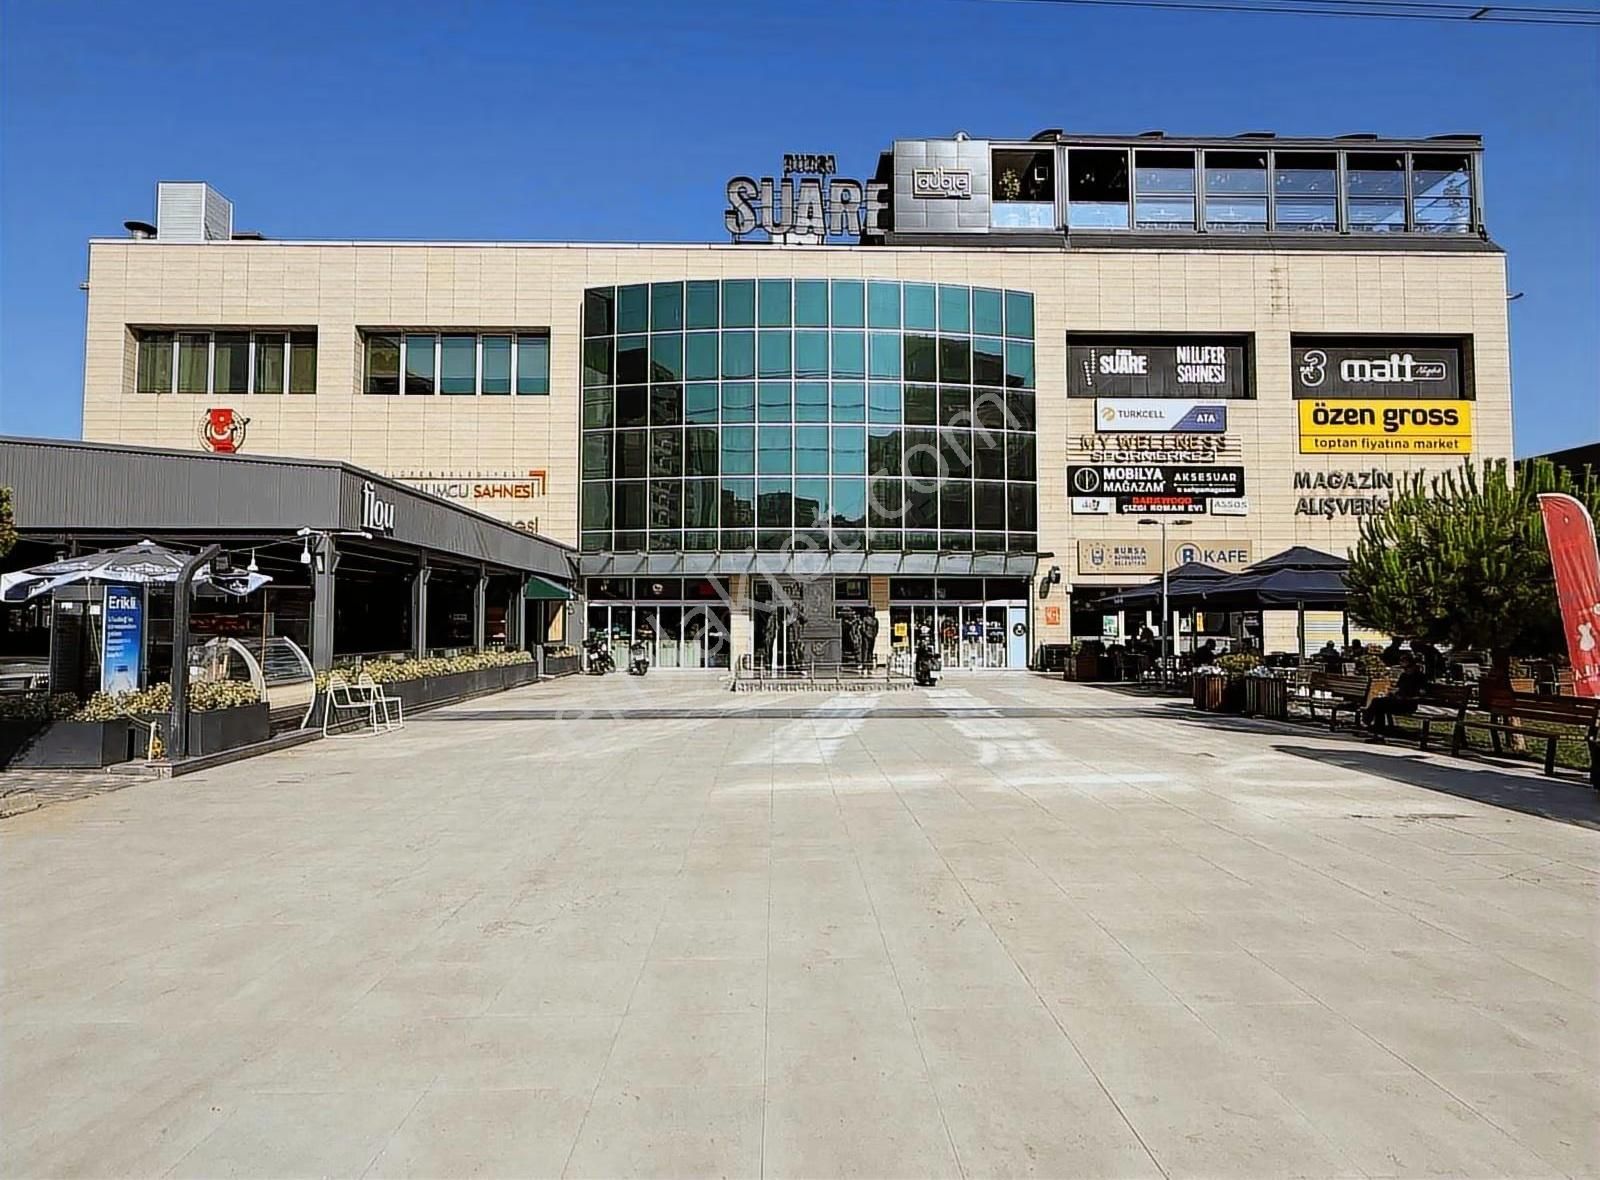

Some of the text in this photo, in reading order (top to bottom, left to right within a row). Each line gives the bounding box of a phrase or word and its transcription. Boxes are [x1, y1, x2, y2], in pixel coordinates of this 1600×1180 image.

[1341, 353, 1413, 382] matt
[1118, 409, 1165, 419] TURKCELL
[1196, 412, 1216, 423] ATA
[1312, 402, 1459, 432] özen gross
[1315, 437, 1459, 449] toptan fiyatına market
[1174, 472, 1237, 481] AKSESUAR
[1204, 549, 1248, 563] KAFE
